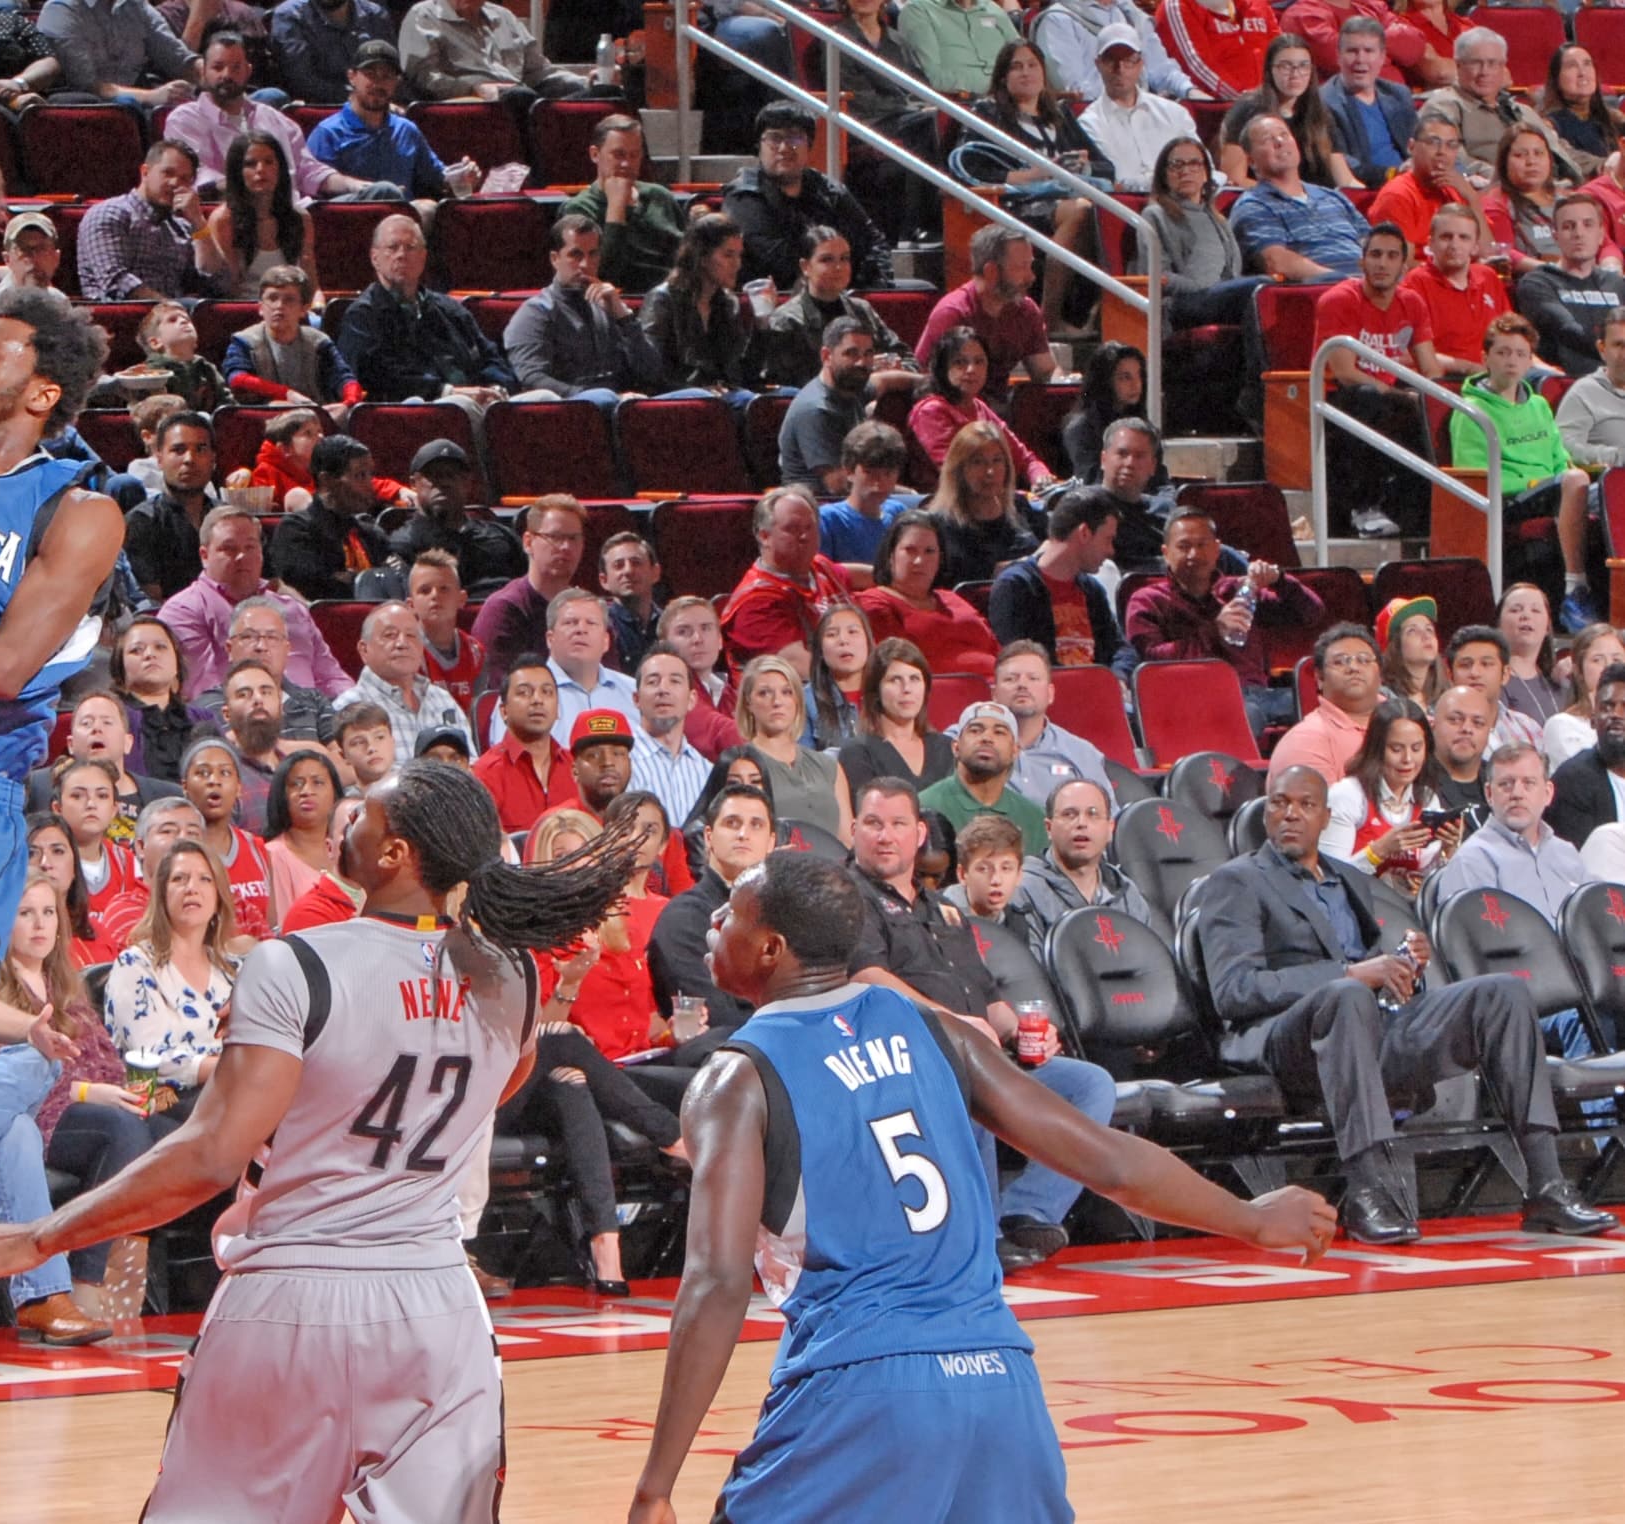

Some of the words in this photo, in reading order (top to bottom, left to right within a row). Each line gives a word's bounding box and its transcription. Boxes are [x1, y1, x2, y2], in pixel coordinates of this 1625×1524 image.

[824, 1034, 912, 1092] DIENG
[349, 1053, 472, 1172] 42
[867, 1108, 951, 1234] 5
[936, 1352, 1007, 1378] WOLVES
